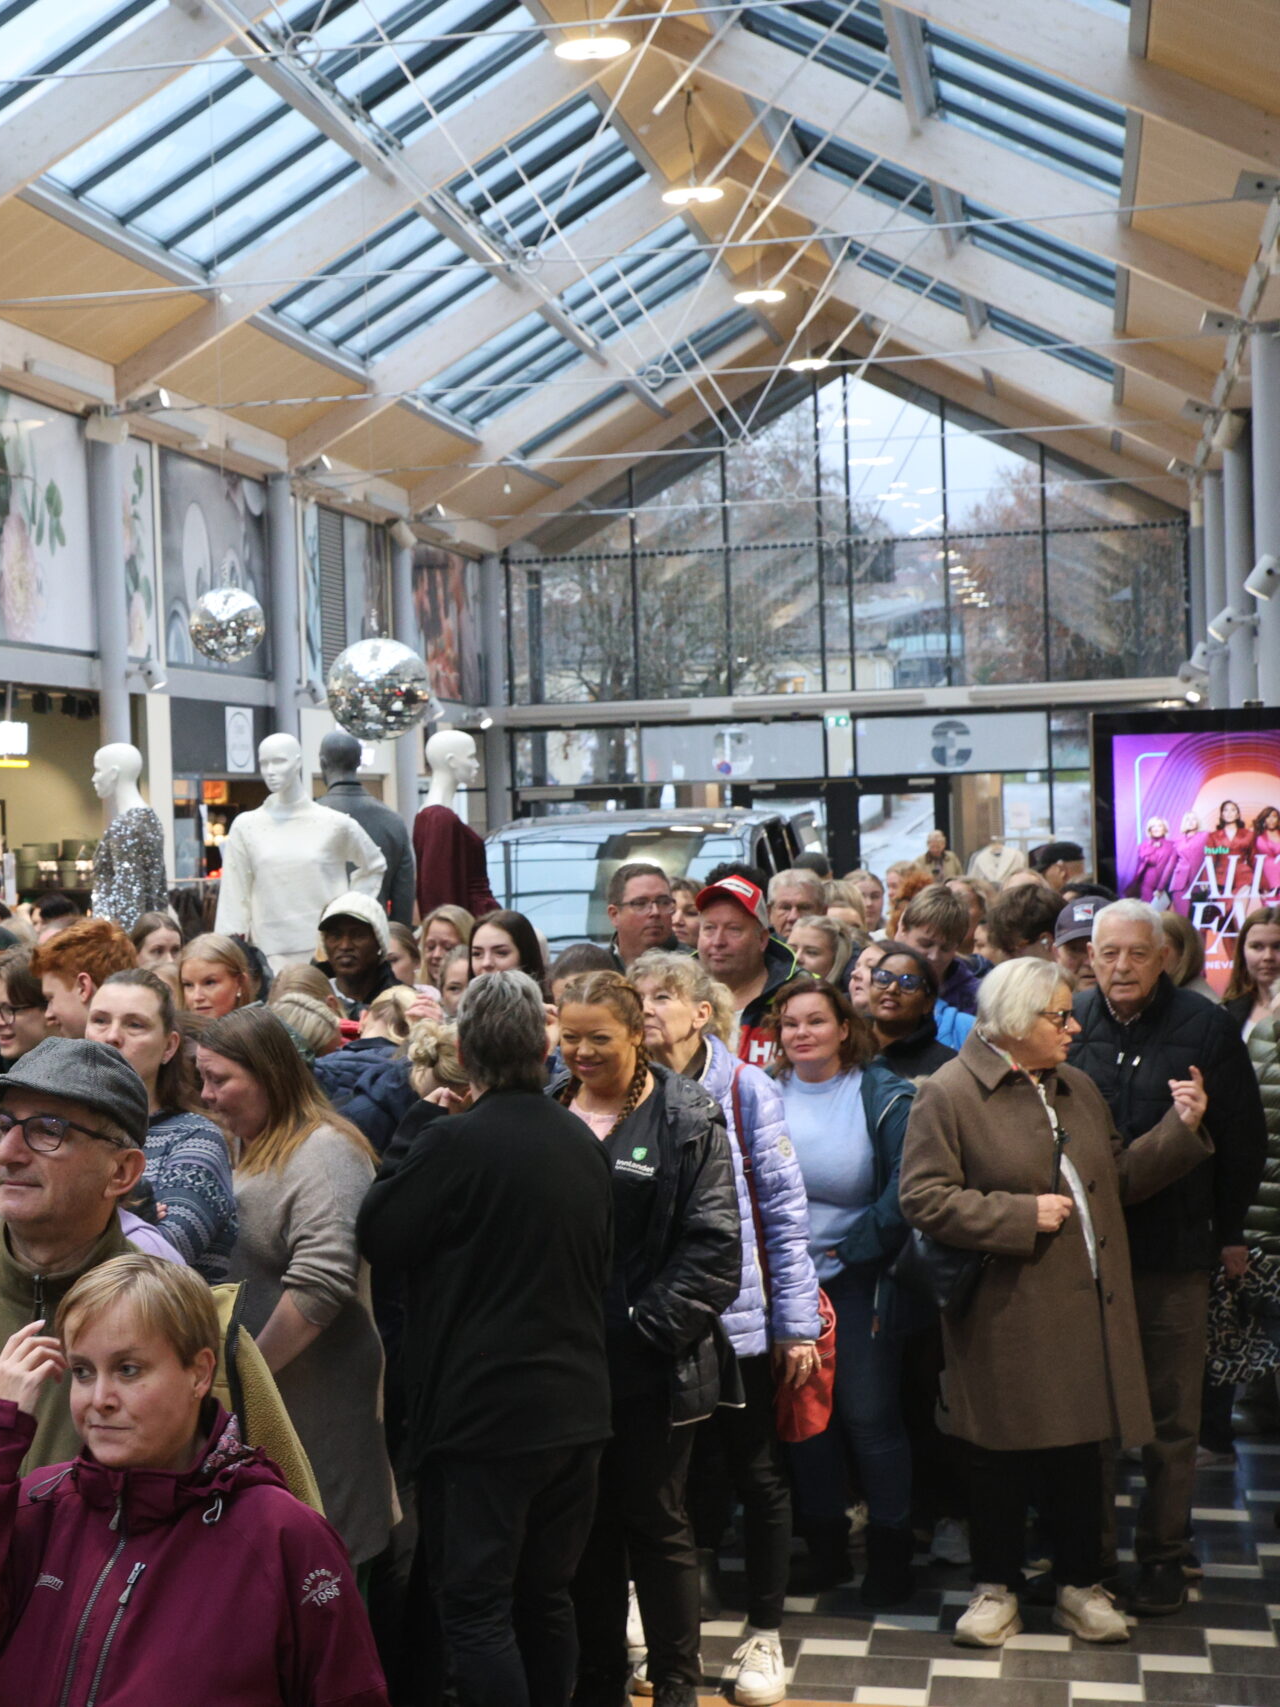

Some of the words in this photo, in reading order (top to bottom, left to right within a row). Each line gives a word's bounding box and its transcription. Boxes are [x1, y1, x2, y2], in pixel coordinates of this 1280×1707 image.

[1204, 846, 1230, 855] hulu
[1192, 901, 1280, 954] FA
[312, 1584, 341, 1607] 1986
